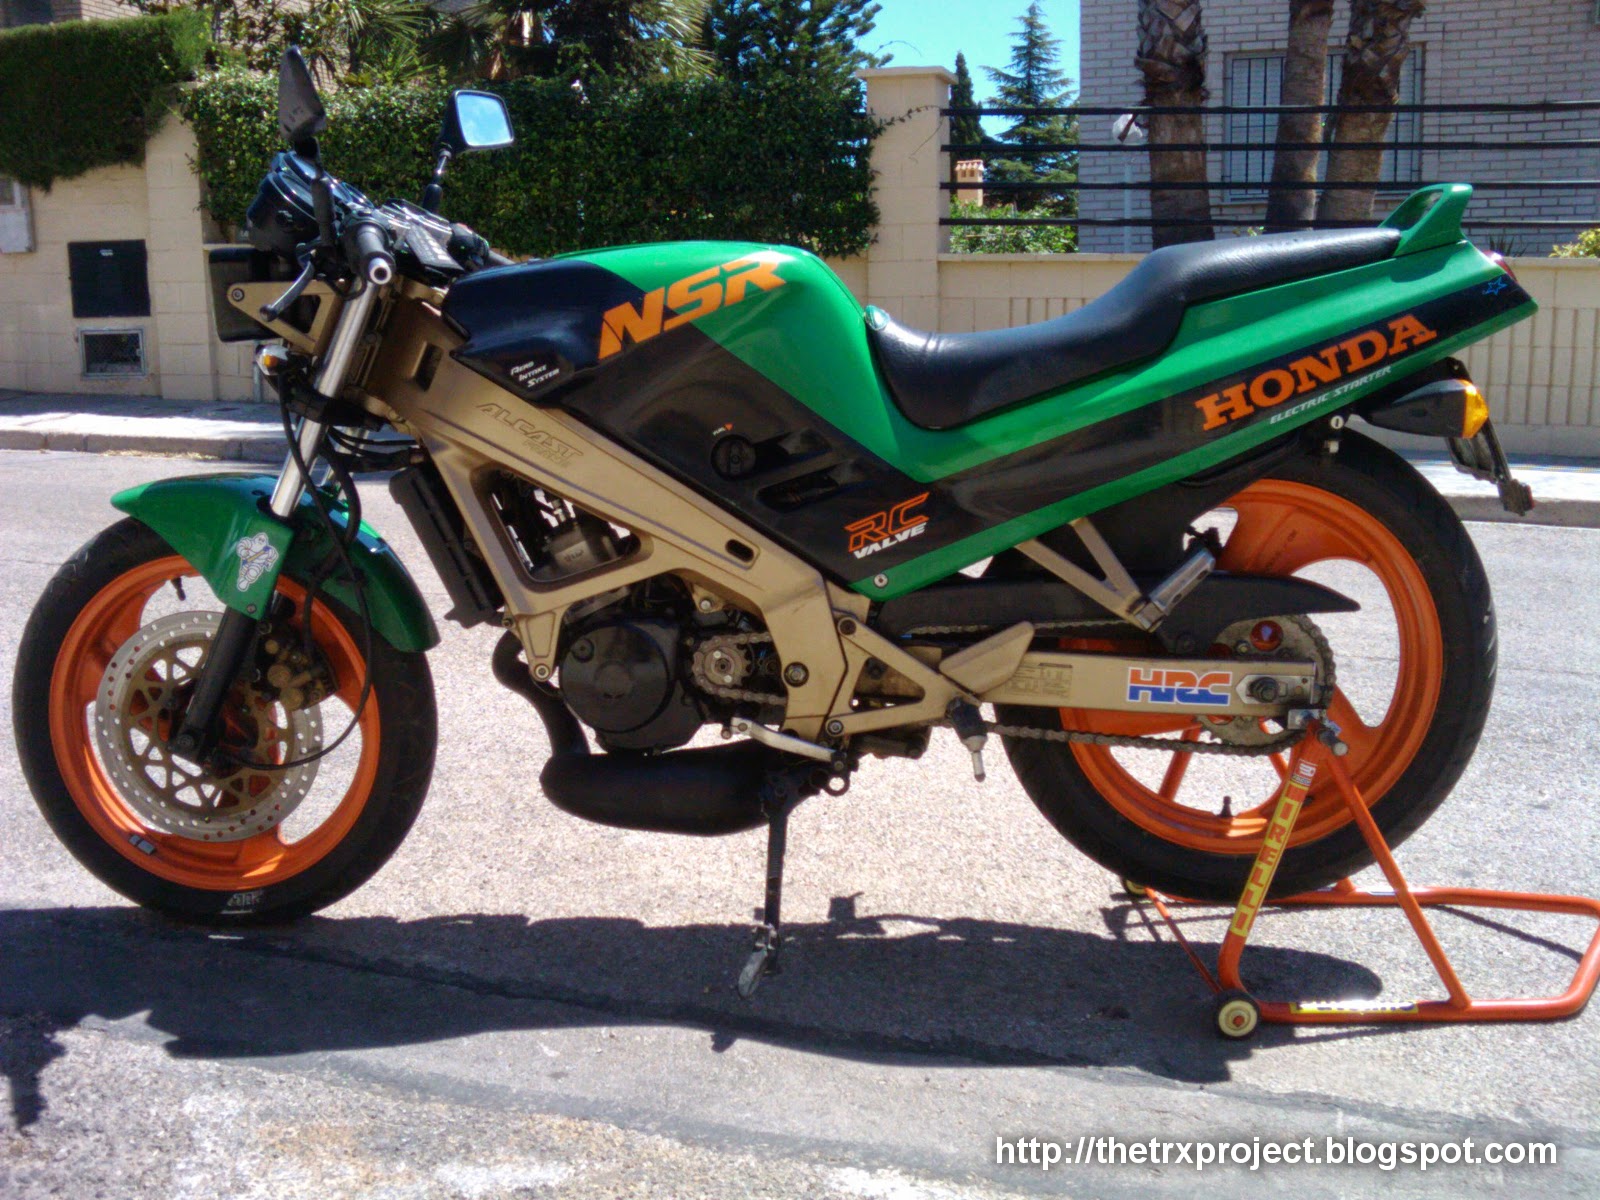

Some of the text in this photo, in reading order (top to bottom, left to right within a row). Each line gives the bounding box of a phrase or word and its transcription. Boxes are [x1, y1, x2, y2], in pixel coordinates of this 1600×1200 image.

[598, 254, 787, 359] NSR
[1195, 313, 1437, 431] HONDA
[1270, 365, 1392, 424] ELECTRIC STARTER
[475, 402, 584, 457] ALCAST
[844, 491, 930, 553] RC
[853, 522, 927, 559] VALVE
[1127, 667, 1232, 706] HRC
